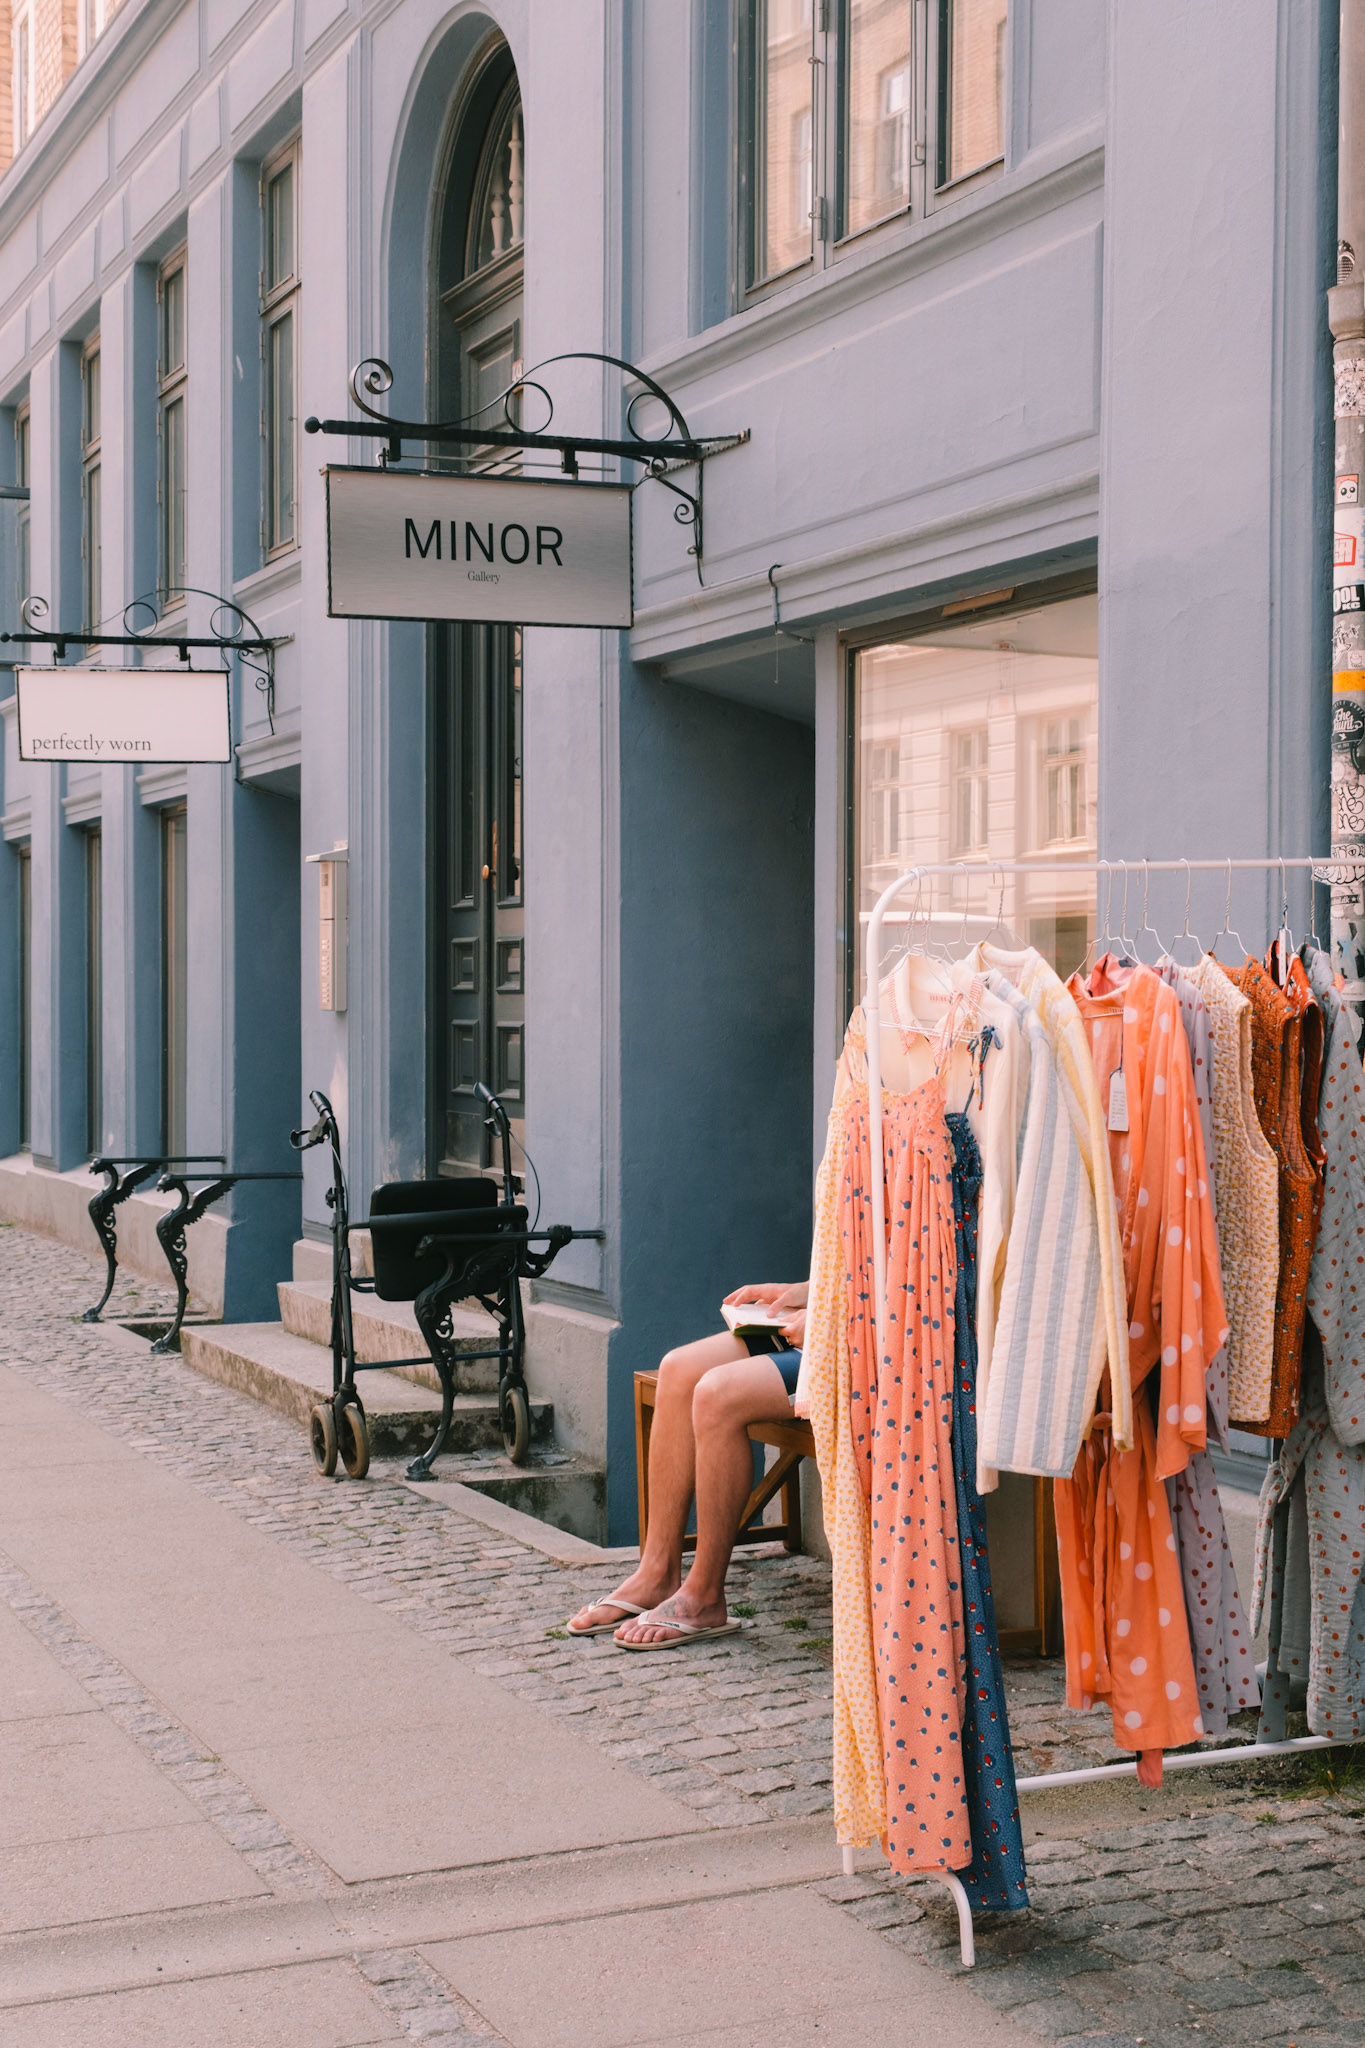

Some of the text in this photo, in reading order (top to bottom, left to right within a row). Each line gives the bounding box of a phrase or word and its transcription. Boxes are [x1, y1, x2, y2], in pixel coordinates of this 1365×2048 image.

[404, 517, 563, 567] MINOR
[467, 570, 501, 585] Gallery
[32, 732, 152, 756] perfectly worn
